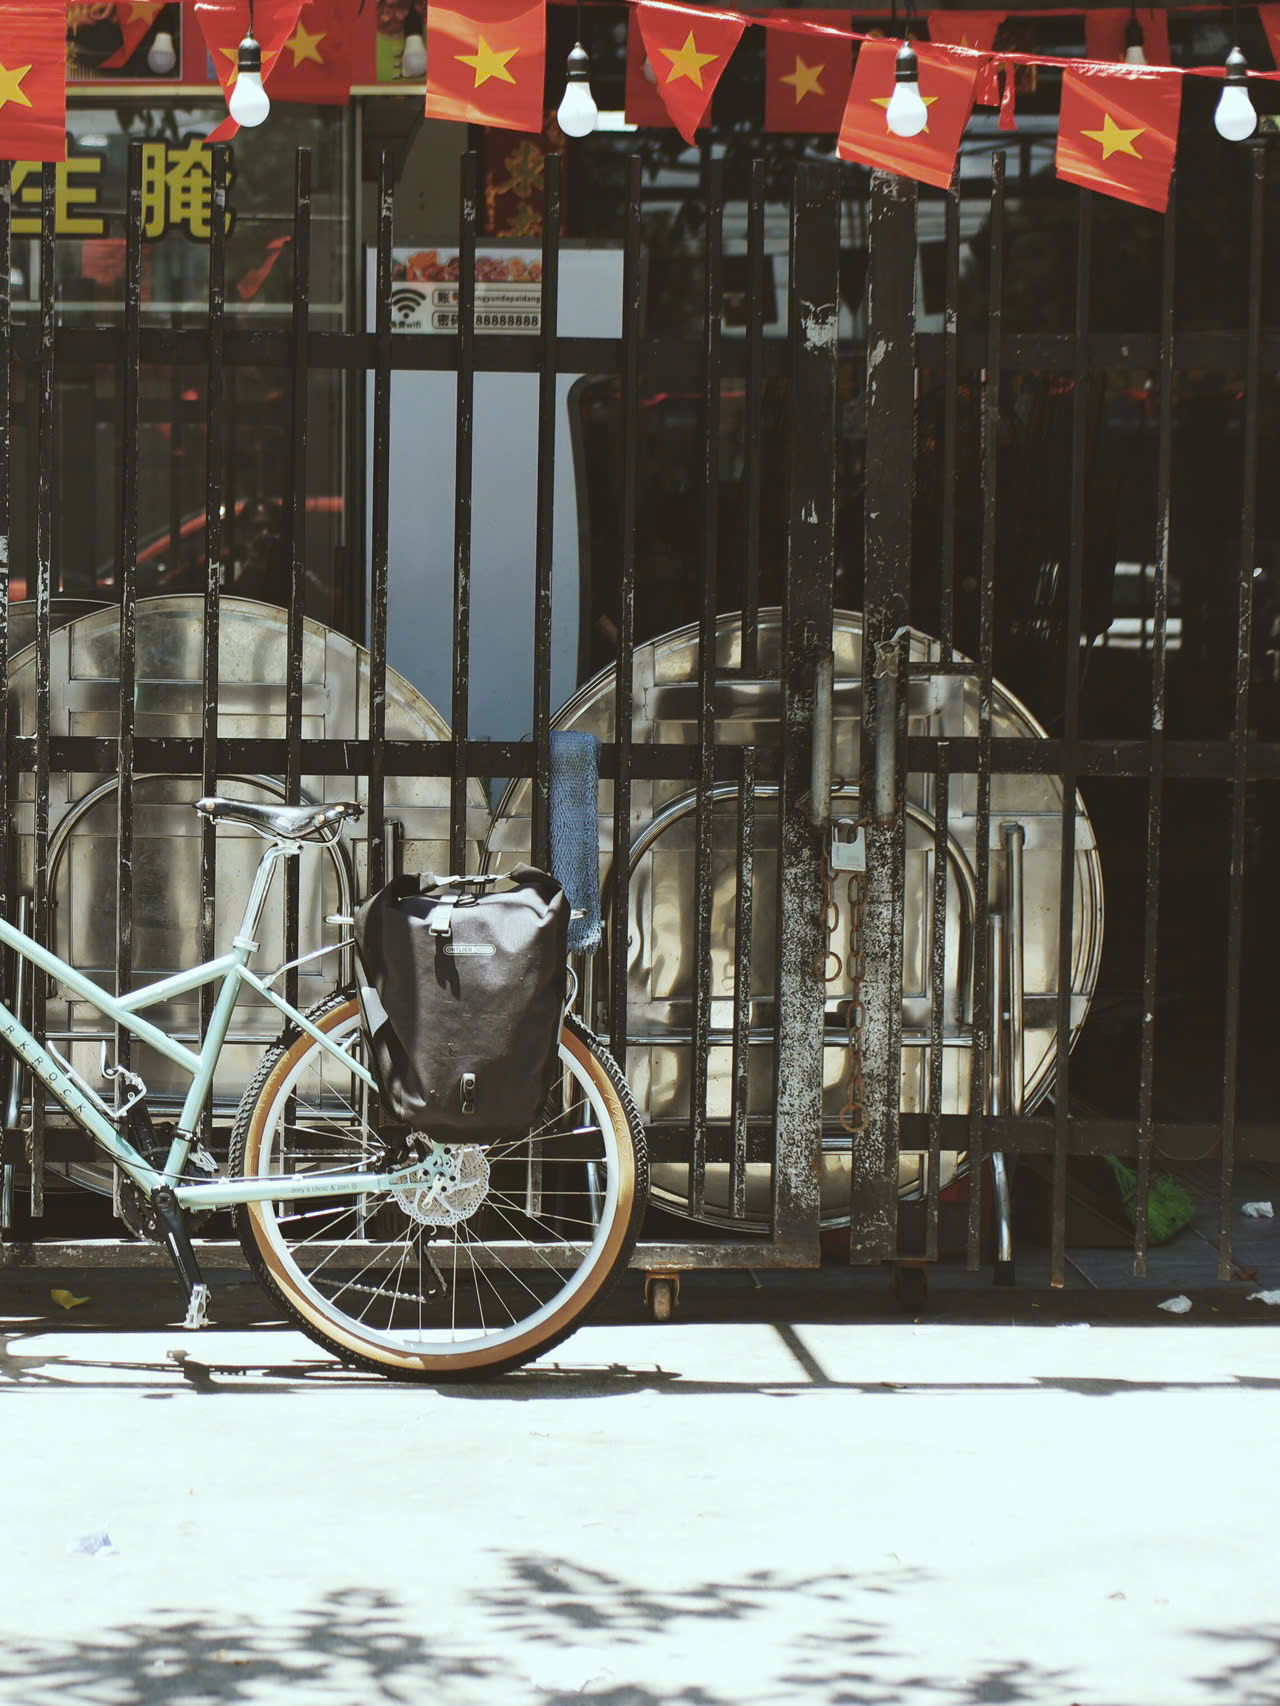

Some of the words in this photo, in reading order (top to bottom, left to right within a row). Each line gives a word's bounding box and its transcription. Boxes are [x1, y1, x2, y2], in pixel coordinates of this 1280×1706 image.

[9, 138, 234, 239] 生腌
[475, 315, 539, 327] 88888888
[330, 1184, 337, 1192] &
